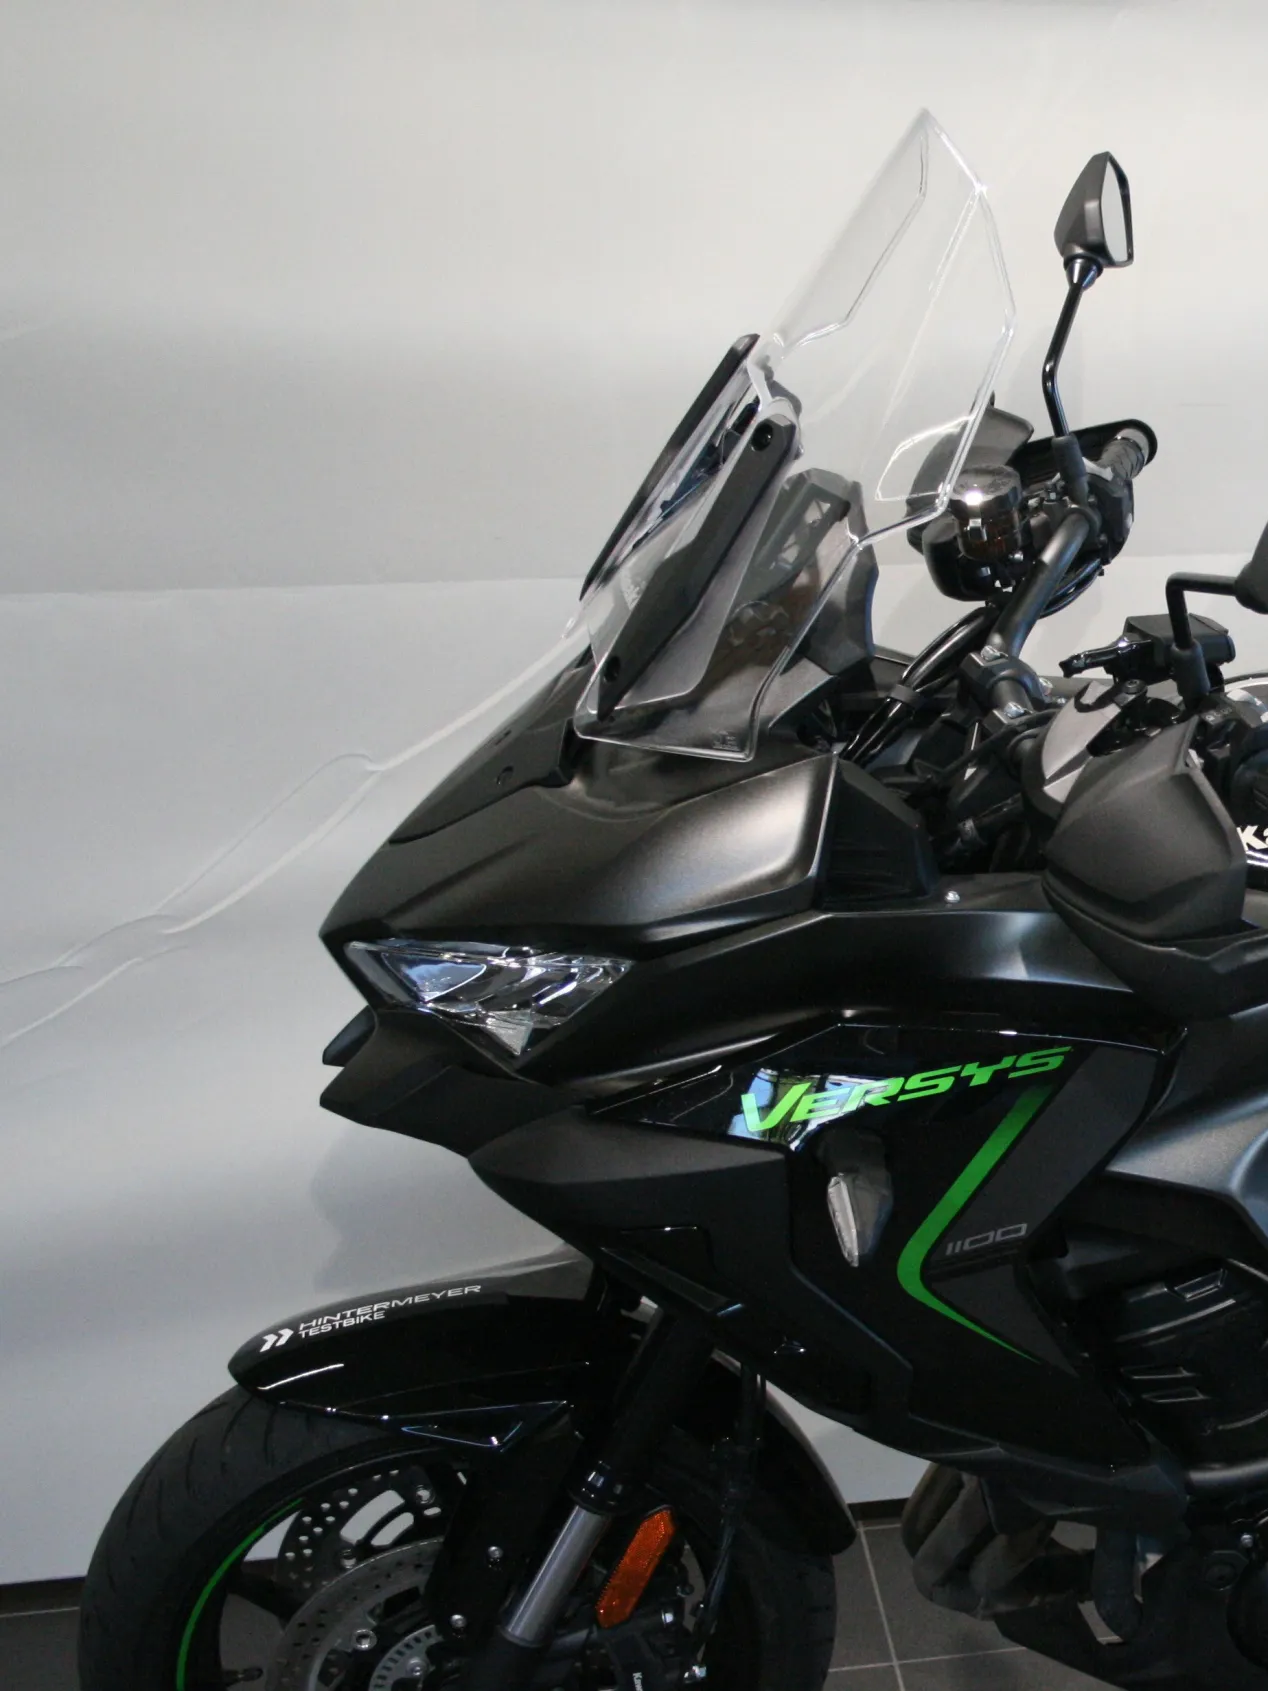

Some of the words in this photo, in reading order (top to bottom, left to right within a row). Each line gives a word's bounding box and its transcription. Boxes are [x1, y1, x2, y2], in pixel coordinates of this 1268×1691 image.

[741, 1046, 1072, 1132] VERSYS
[945, 1223, 1027, 1255] 1100
[299, 1285, 481, 1331] HINTERMEYER
[299, 1310, 386, 1338] TESTBIKE
